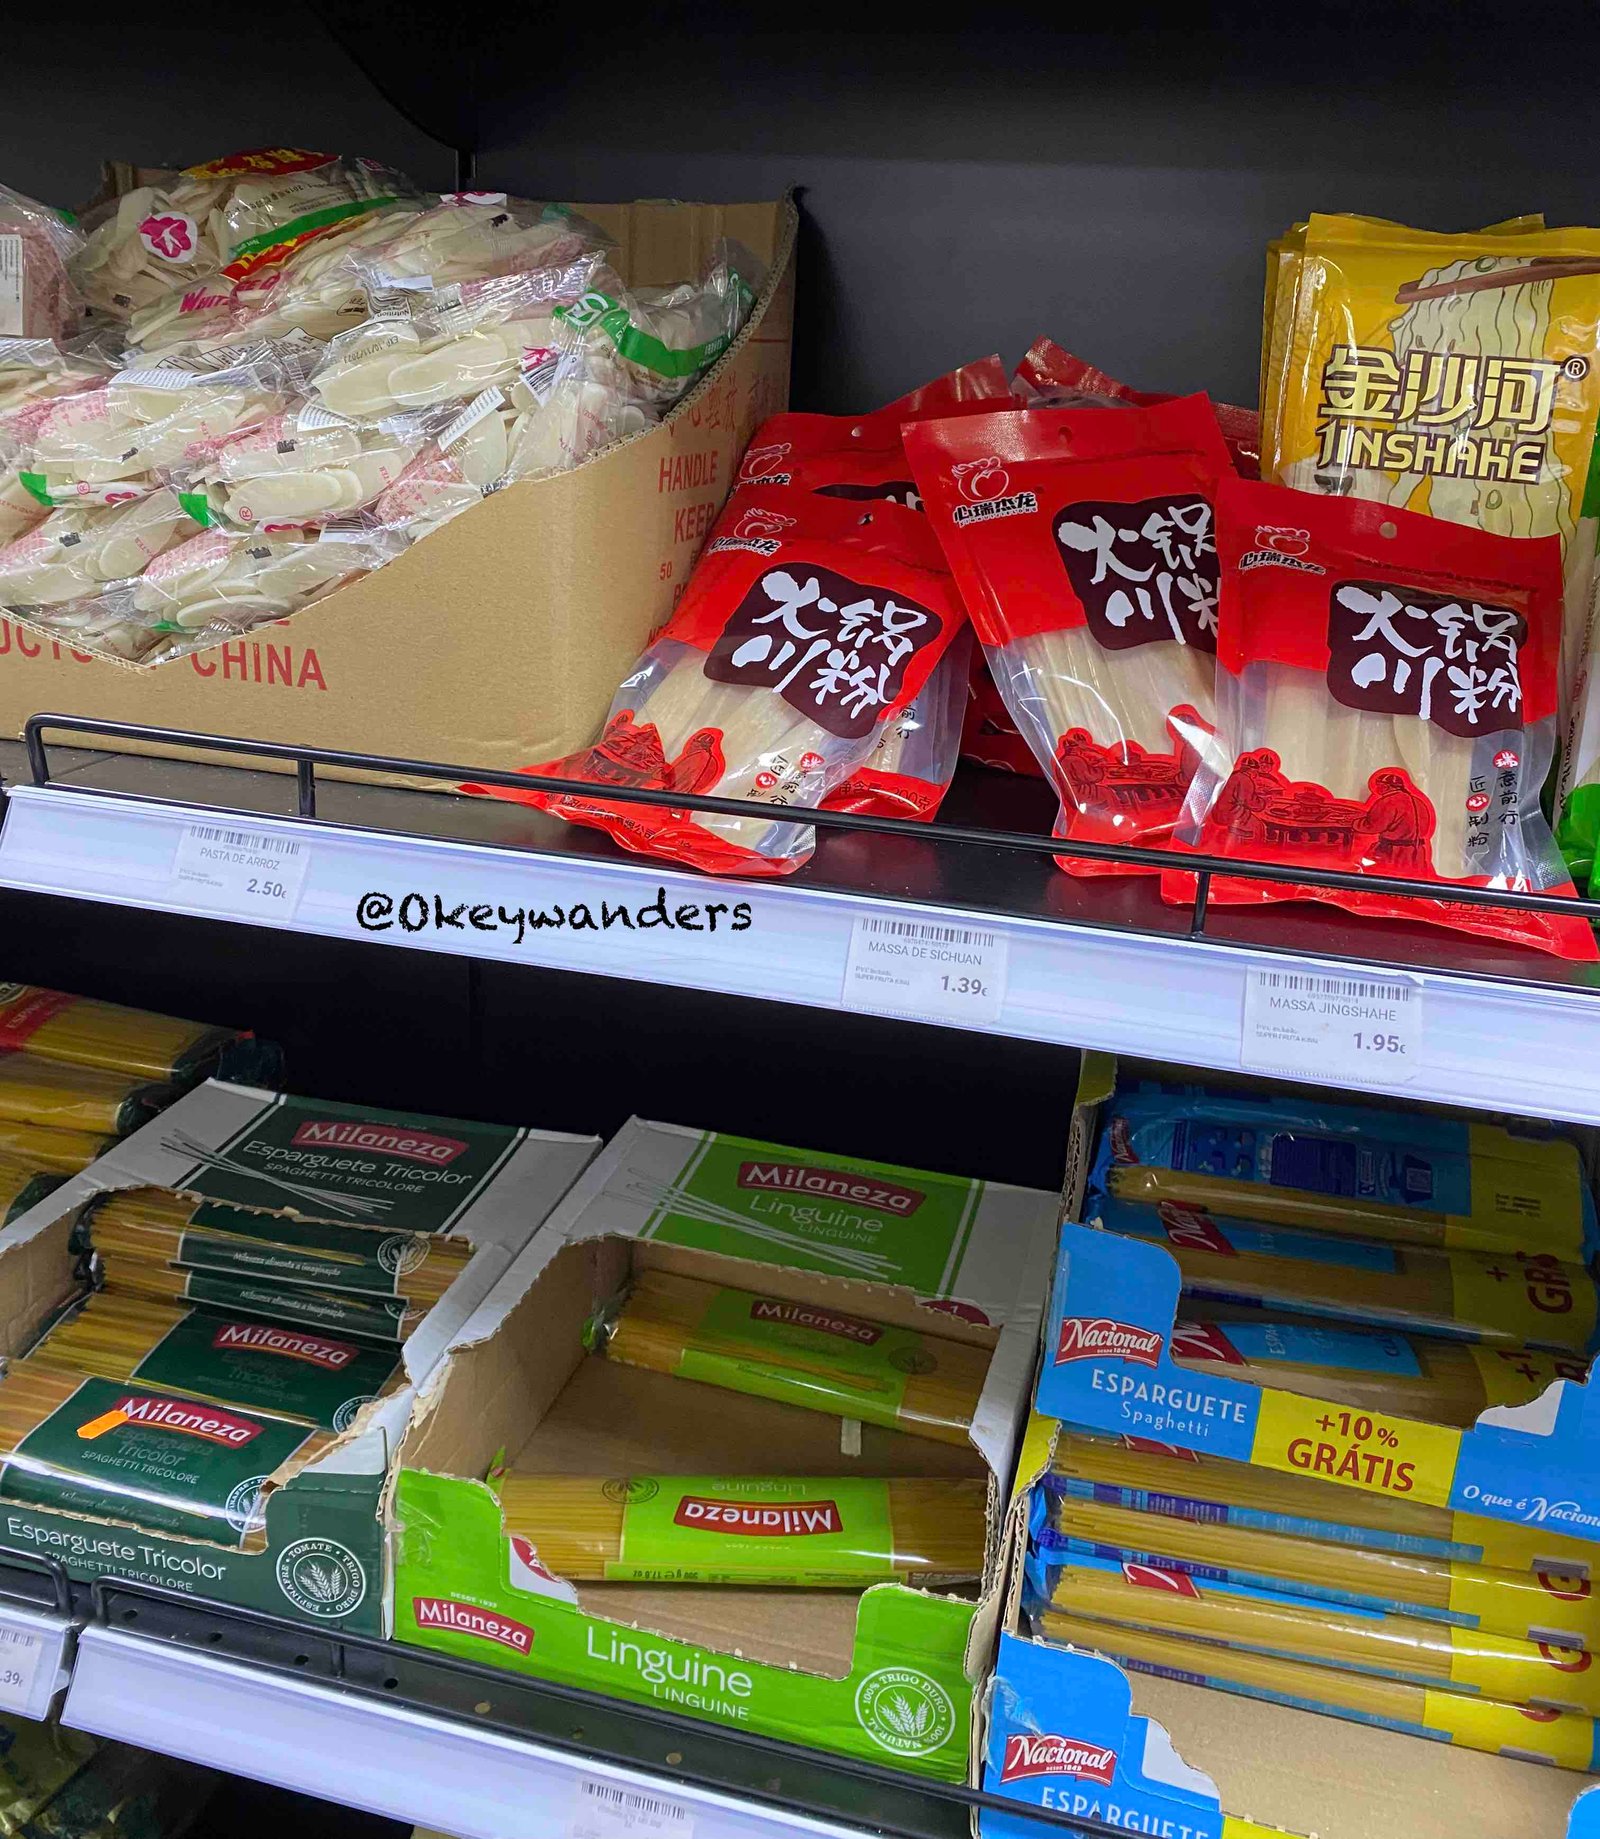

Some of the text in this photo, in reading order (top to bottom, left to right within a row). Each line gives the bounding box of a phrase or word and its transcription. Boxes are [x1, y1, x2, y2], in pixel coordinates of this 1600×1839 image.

[1318, 345, 1565, 435] 金沙河
[658, 451, 718, 493] HANDLE
[1316, 421, 1546, 485] JINSHAHE
[659, 561, 672, 580] 50
[751, 571, 927, 666] 火锅
[1336, 585, 1518, 664] 火锅
[1351, 653, 1522, 724] 川粉
[200, 847, 230, 862] PASTA
[232, 853, 245, 864] DE
[246, 856, 281, 871] ARROZ
[247, 878, 288, 899] 2.50€
[868, 941, 982, 966] MASSA DE SICHUAN
[941, 975, 988, 997] 1.39€
[1270, 997, 1316, 1013] MASSA
[1319, 1004, 1397, 1022] JINGSHAHE
[1353, 1032, 1406, 1054] 1.95€
[302, 1122, 454, 1160] Milaneza
[244, 1140, 473, 1186] Esparguete Tricolor
[263, 1162, 426, 1195] SPAGHETTI TRICOLORE
[746, 1164, 912, 1211] Milaneza
[750, 1194, 883, 1233] Linguine
[757, 1303, 875, 1341] Milaneza
[1061, 1318, 1163, 1354] Nacional
[219, 1325, 349, 1365] Milaneza
[1092, 1368, 1248, 1424] ESPARGUETE
[121, 1398, 254, 1442] Milaneza
[1121, 1401, 1210, 1437] Spaghetti
[1315, 1412, 1399, 1448] +10%
[81, 1450, 201, 1484] SPAGHETTI TRICOLORE
[118, 1441, 187, 1467] Tricolor
[1287, 1438, 1416, 1492] GRÁTIS
[711, 1479, 808, 1496] Linguine
[1463, 1485, 1480, 1499] O
[1481, 1493, 1513, 1507] que
[1515, 1498, 1528, 1510] é
[685, 1501, 834, 1534] Milaneza
[7, 1517, 227, 1581] Esparguete Tricolor
[288, 1542, 333, 1559] TOMATE
[281, 1563, 321, 1612] ESPINAFRE
[335, 1554, 361, 1612] TRIGO DURO
[420, 1599, 527, 1647] Milaneza
[587, 1625, 754, 1697] Linguine
[653, 1682, 749, 1721] LINGUINE
[879, 1672, 919, 1685] TRIGO
[920, 1682, 947, 1713] DURO
[1007, 1735, 1115, 1772] Nacional
